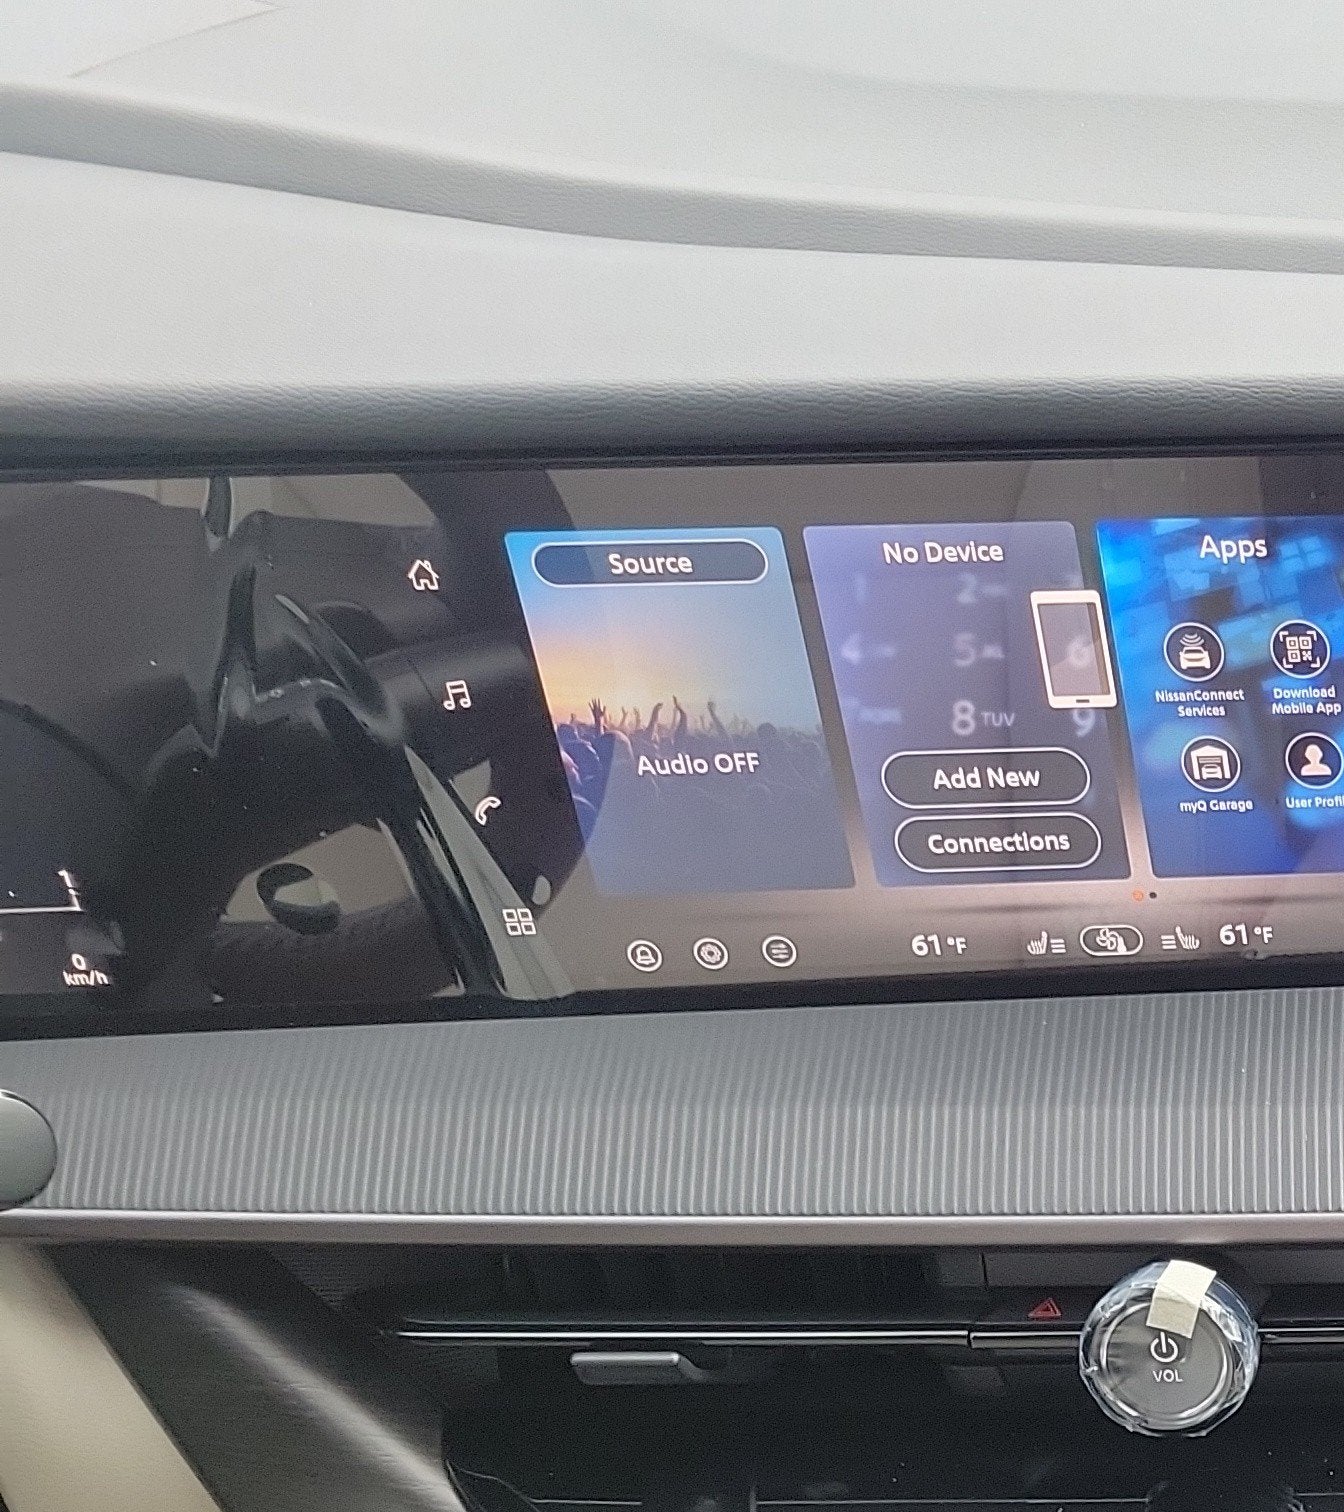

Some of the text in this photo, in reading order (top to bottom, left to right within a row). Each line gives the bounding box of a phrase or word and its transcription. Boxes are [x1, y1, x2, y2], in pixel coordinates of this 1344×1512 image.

[884, 540, 1004, 564] No Device
[1200, 536, 1267, 563] Apps
[608, 552, 693, 575] Source
[1155, 689, 1245, 703] NissanConnect
[1273, 685, 1336, 699] Download
[952, 700, 1015, 736] 8 TUV
[1177, 704, 1226, 717] Services
[1272, 702, 1342, 716] Mobile App
[637, 752, 760, 775] Audio OFF
[933, 766, 1041, 790] Add New
[1180, 800, 1254, 815] myQ Garage
[1286, 797, 1312, 809] User
[928, 831, 1071, 855] Connections
[911, 934, 967, 956] 61 °F
[1219, 924, 1274, 946] 61 °F
[71, 953, 86, 971] 0
[63, 970, 109, 986] km/h
[1153, 1369, 1183, 1383] VOL
